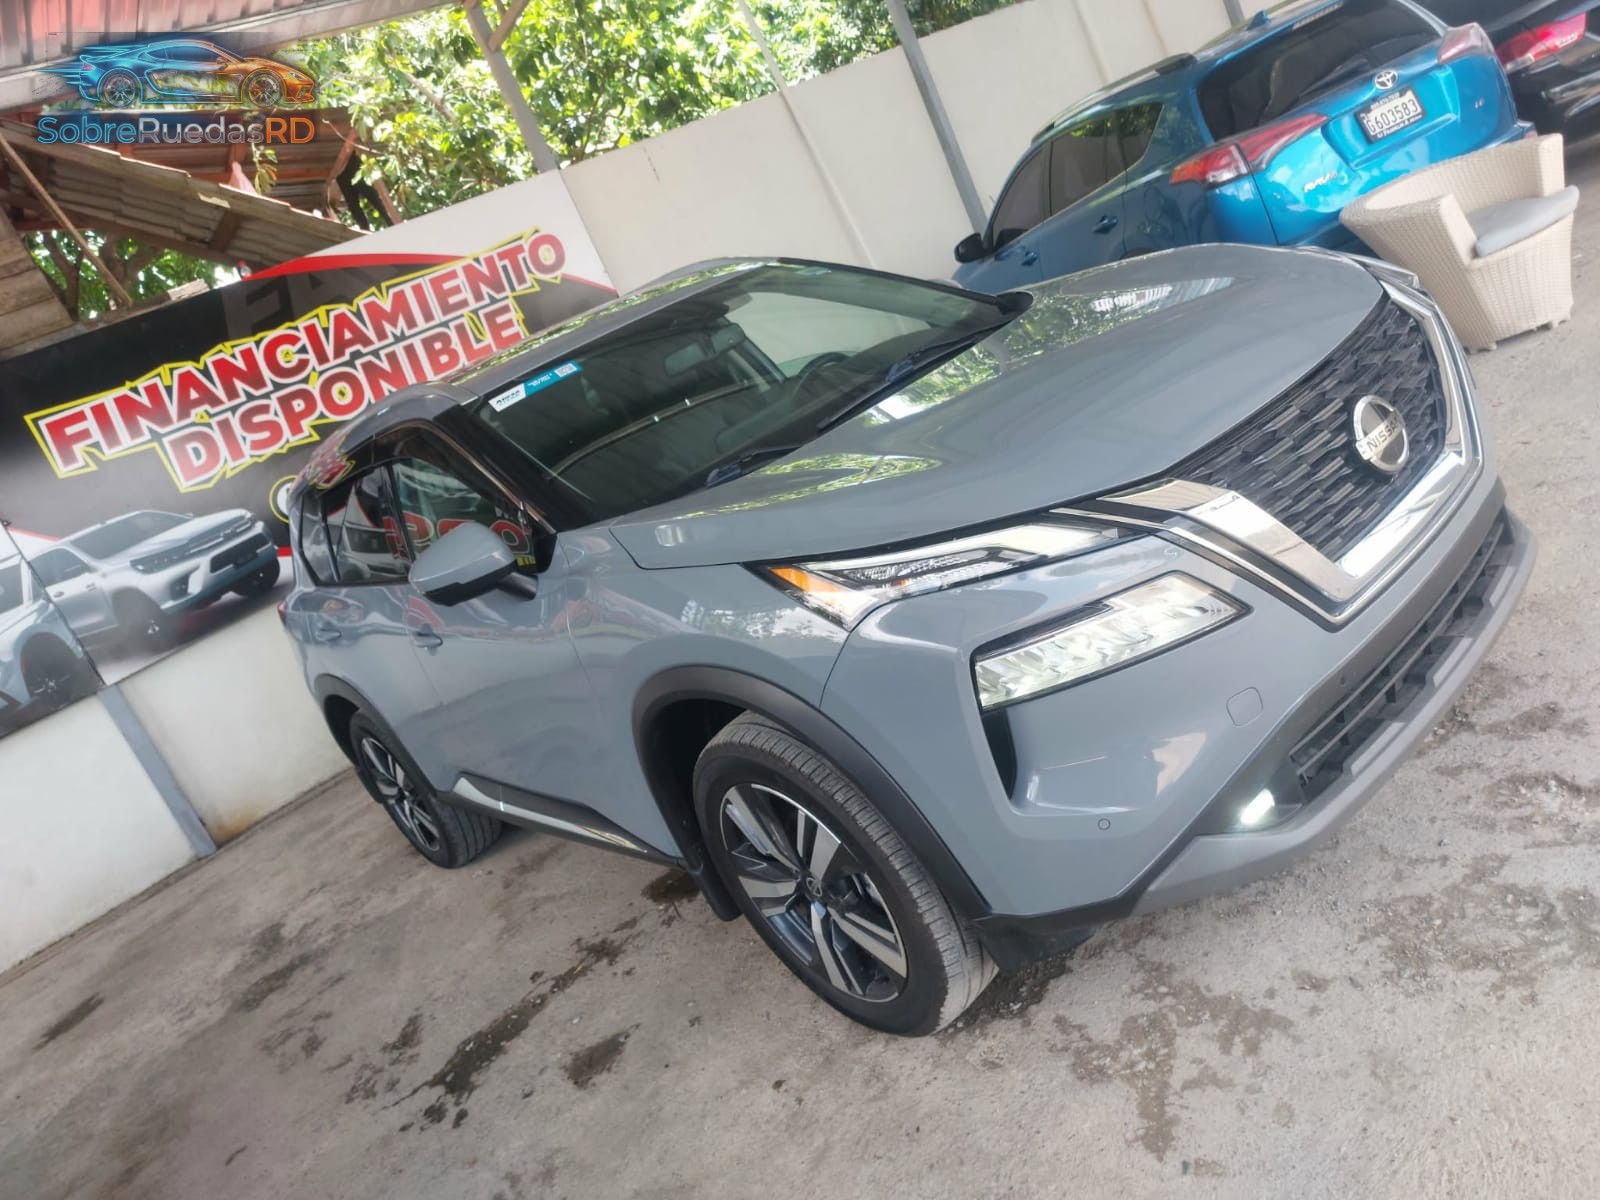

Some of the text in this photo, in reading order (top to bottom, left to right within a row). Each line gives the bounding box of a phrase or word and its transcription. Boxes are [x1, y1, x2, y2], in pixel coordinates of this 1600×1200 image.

[1366, 98, 1418, 133] G603583
[38, 232, 568, 474] FINANCIAMIENTO
[162, 300, 524, 488] DISPONIBLE
